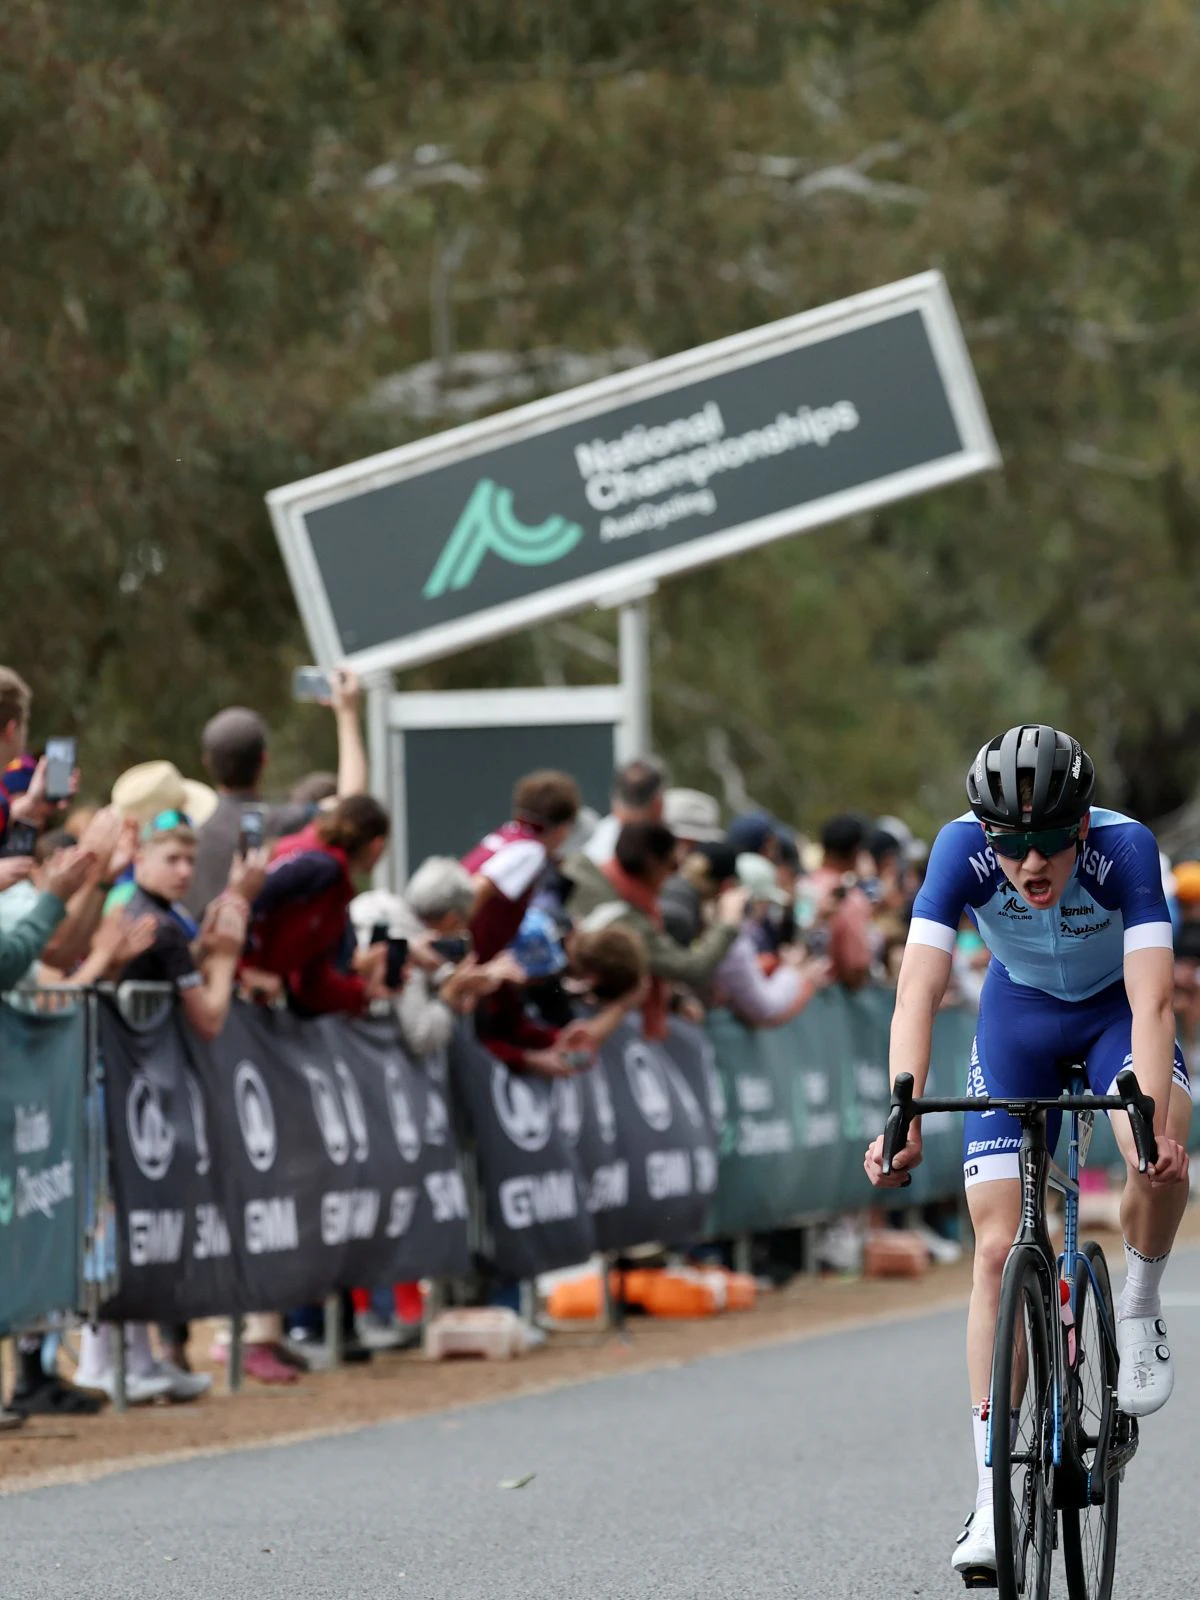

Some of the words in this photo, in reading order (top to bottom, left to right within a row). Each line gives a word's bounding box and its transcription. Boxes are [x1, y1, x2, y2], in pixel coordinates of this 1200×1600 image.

[574, 401, 725, 478] National
[585, 400, 860, 511] Championships
[967, 1136, 1023, 1156] Santini
[1024, 1162, 1037, 1229] FACTOR
